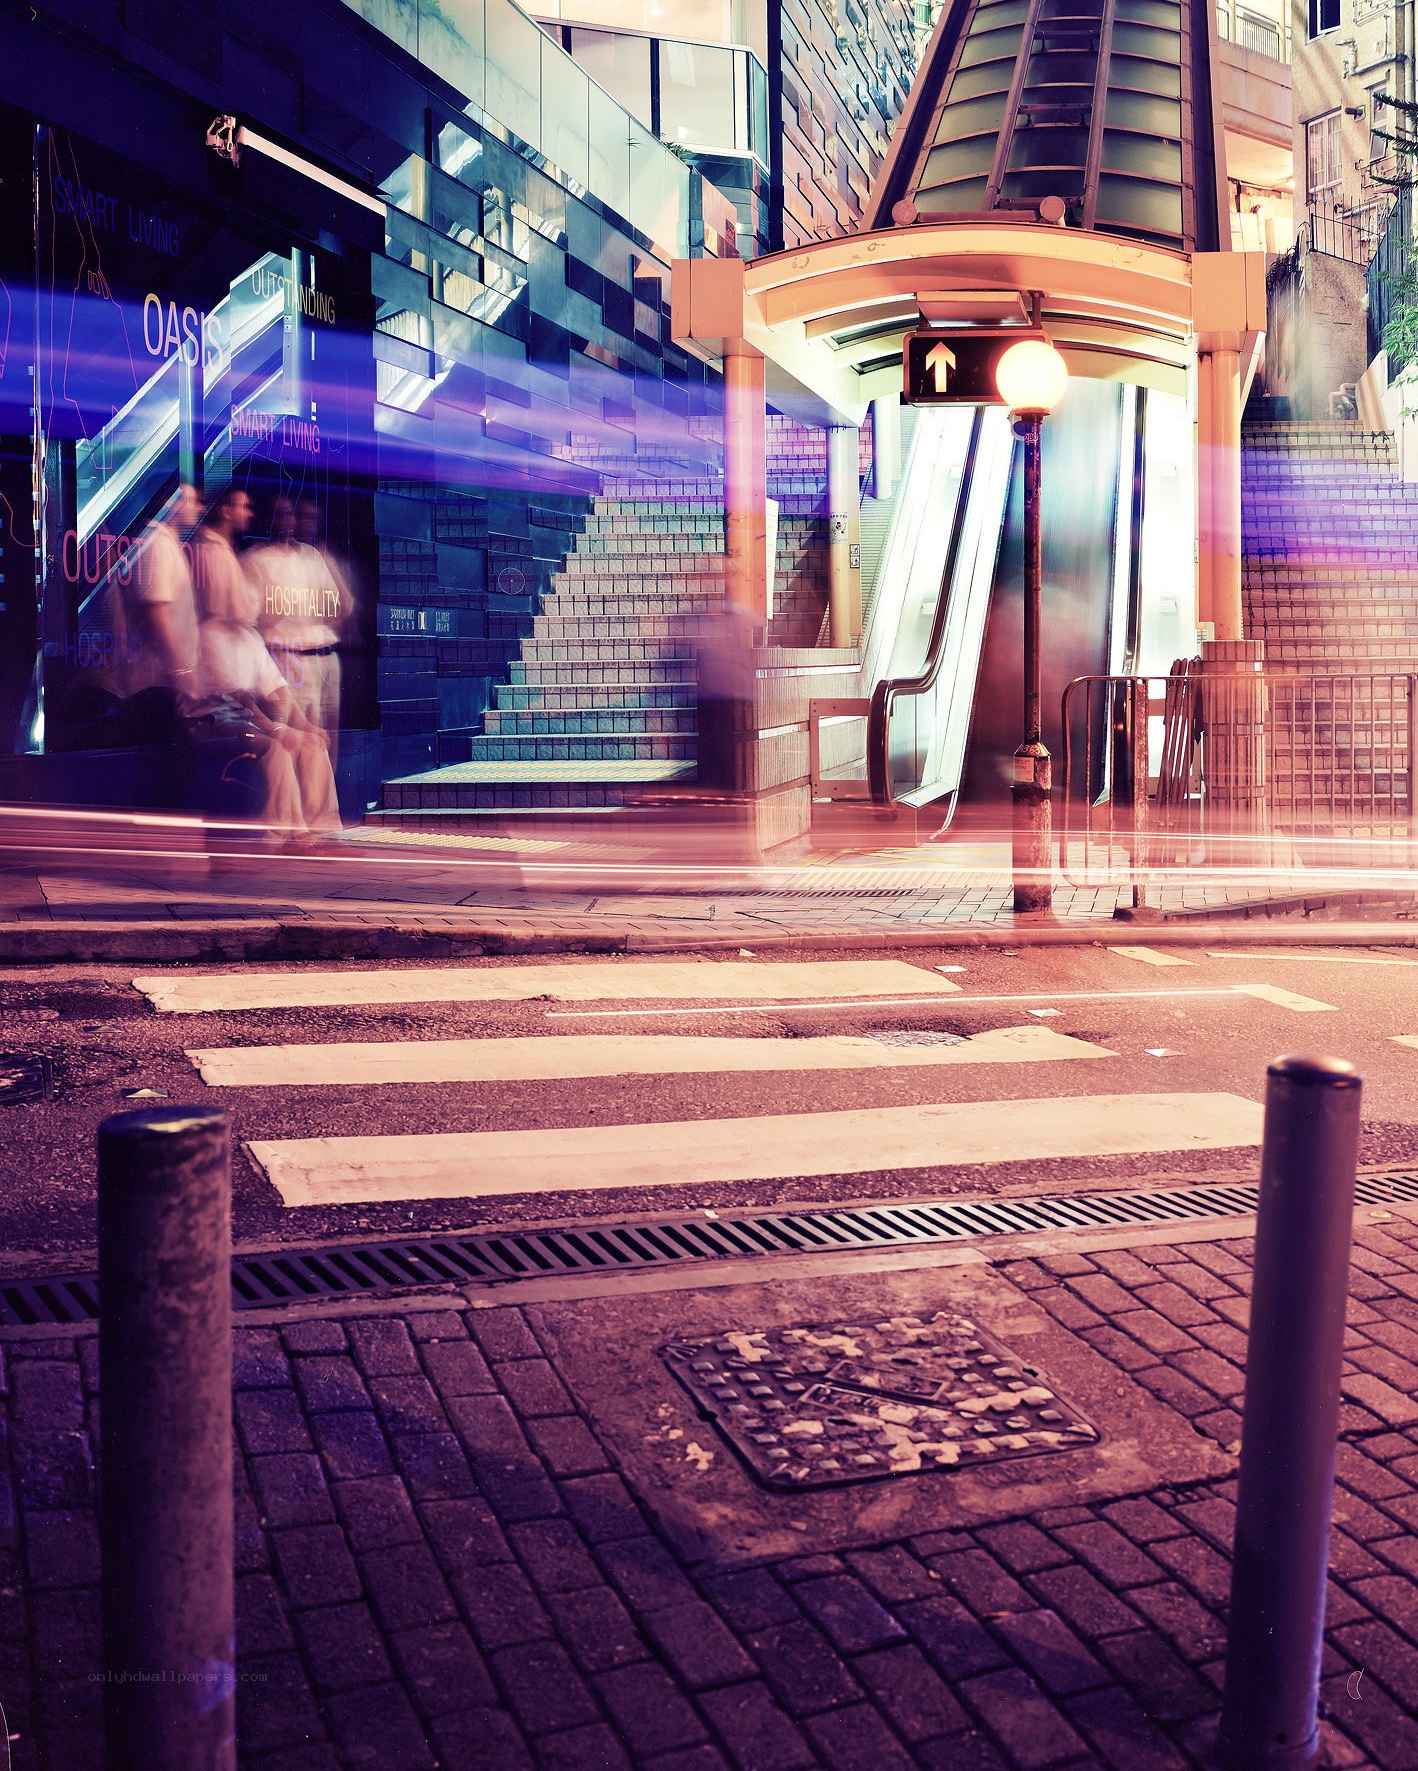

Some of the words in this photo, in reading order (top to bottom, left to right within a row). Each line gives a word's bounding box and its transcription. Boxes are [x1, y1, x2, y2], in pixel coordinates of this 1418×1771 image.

[53, 175, 119, 233] SMART
[128, 206, 180, 258] LIVING
[251, 267, 336, 325] OUTSTANDING
[143, 292, 224, 373] OASIS
[231, 403, 276, 443] SMART
[282, 417, 321, 454] LIVING
[265, 585, 341, 618] HOSPITALITY
